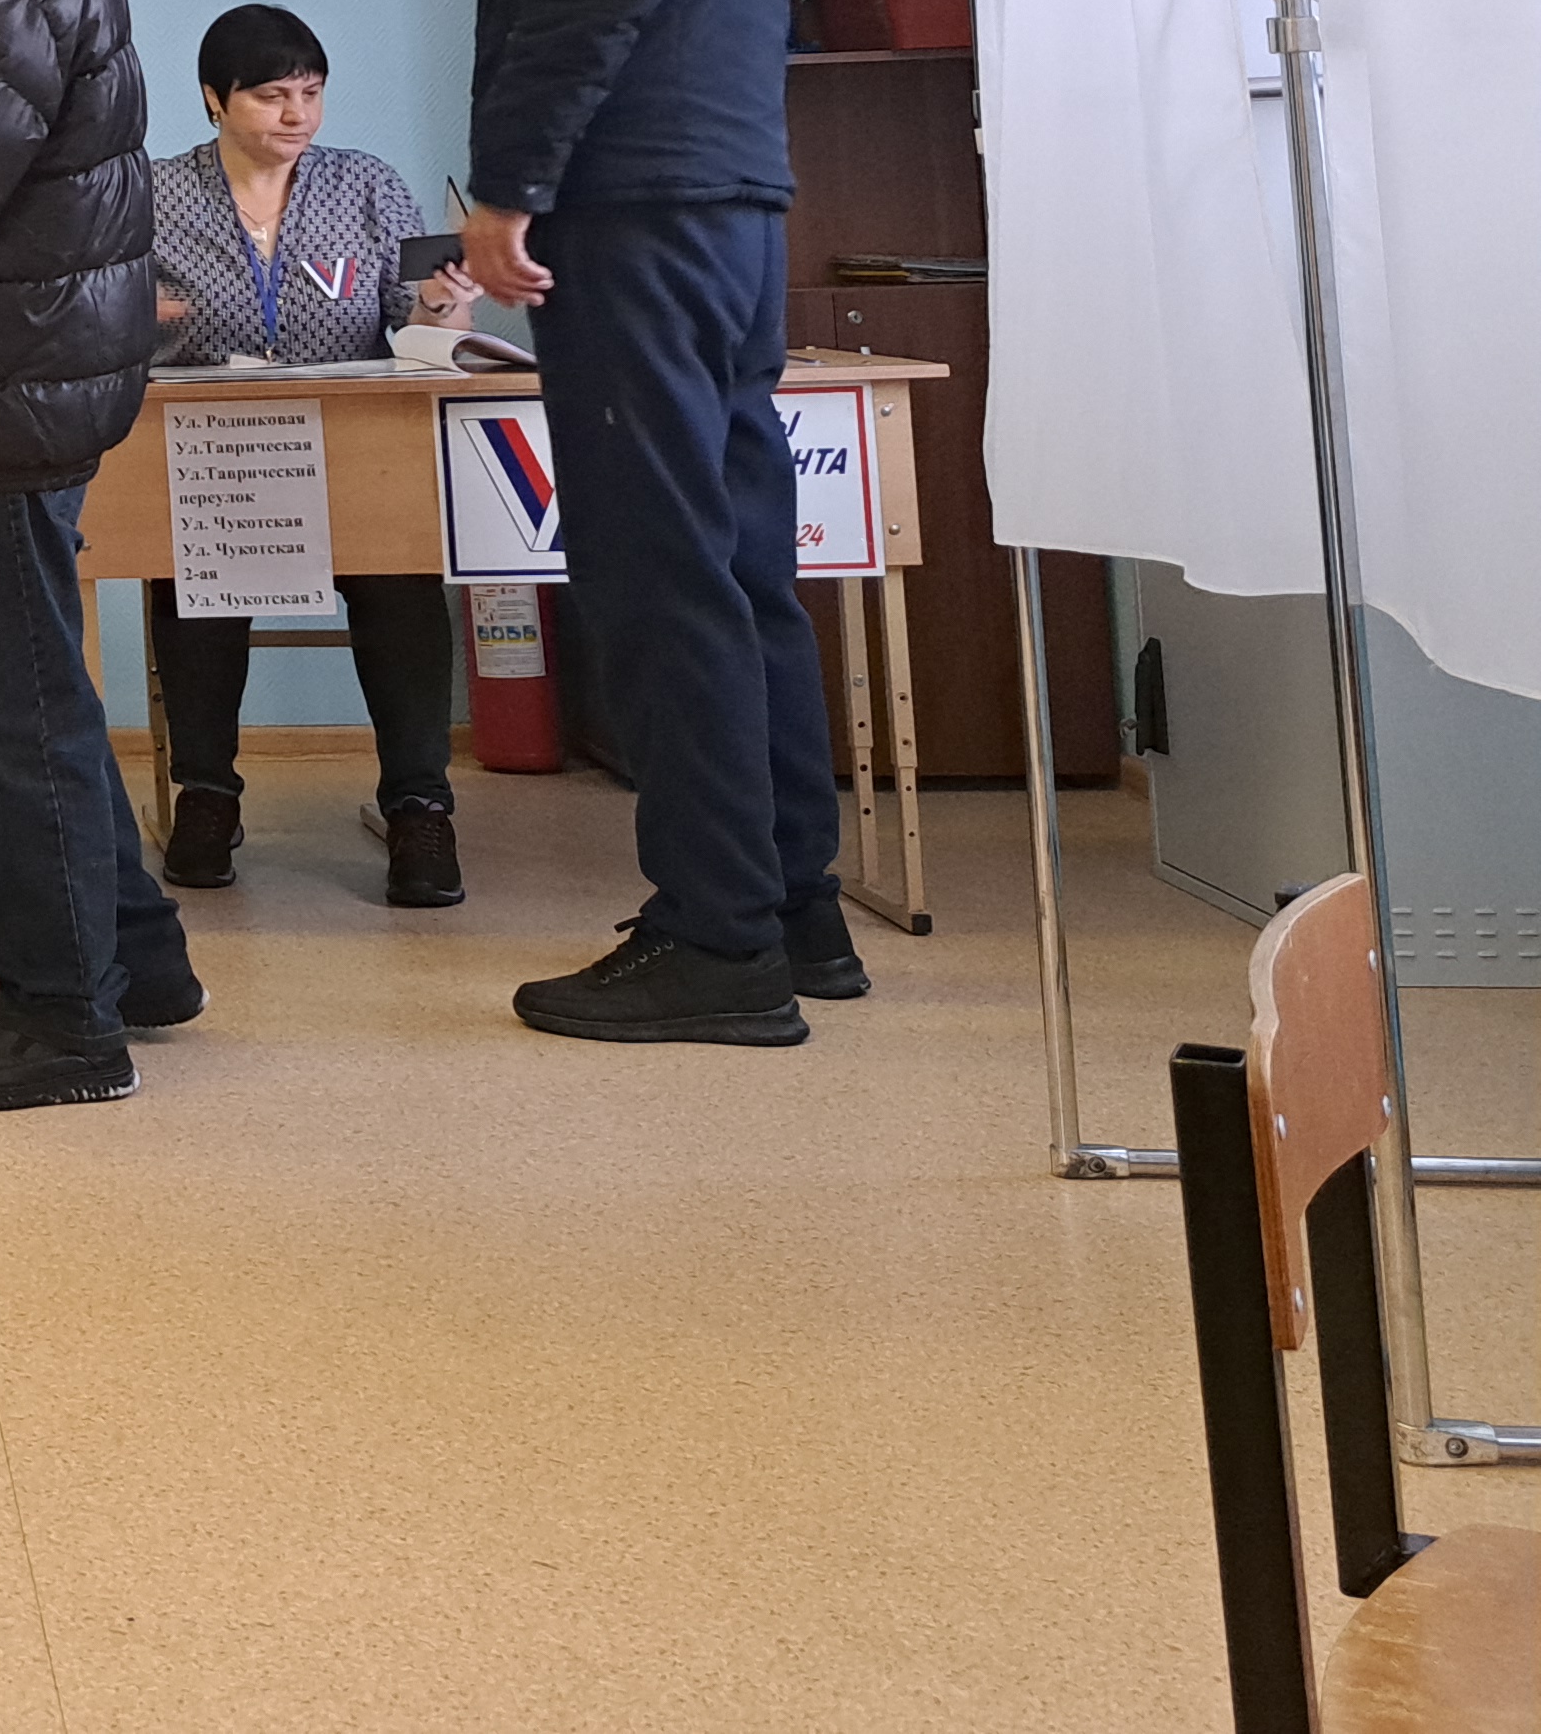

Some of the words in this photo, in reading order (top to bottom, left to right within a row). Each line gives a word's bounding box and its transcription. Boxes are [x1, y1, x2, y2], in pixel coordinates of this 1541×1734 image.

[174, 416, 202, 429] Ул.
[206, 414, 306, 428] Родниковая
[175, 440, 312, 457] Ул.Таврическая
[177, 464, 316, 483] Ул.Таврический
[179, 493, 256, 508] переулок
[181, 517, 209, 531] Ул.
[214, 516, 304, 533] Чукотская
[183, 543, 211, 557] Ул.
[216, 542, 305, 559] Чукотская
[184, 567, 219, 581] 2-ая
[186, 593, 215, 607] Ул.
[220, 592, 310, 610] Чукотская
[314, 590, 324, 604] 3
